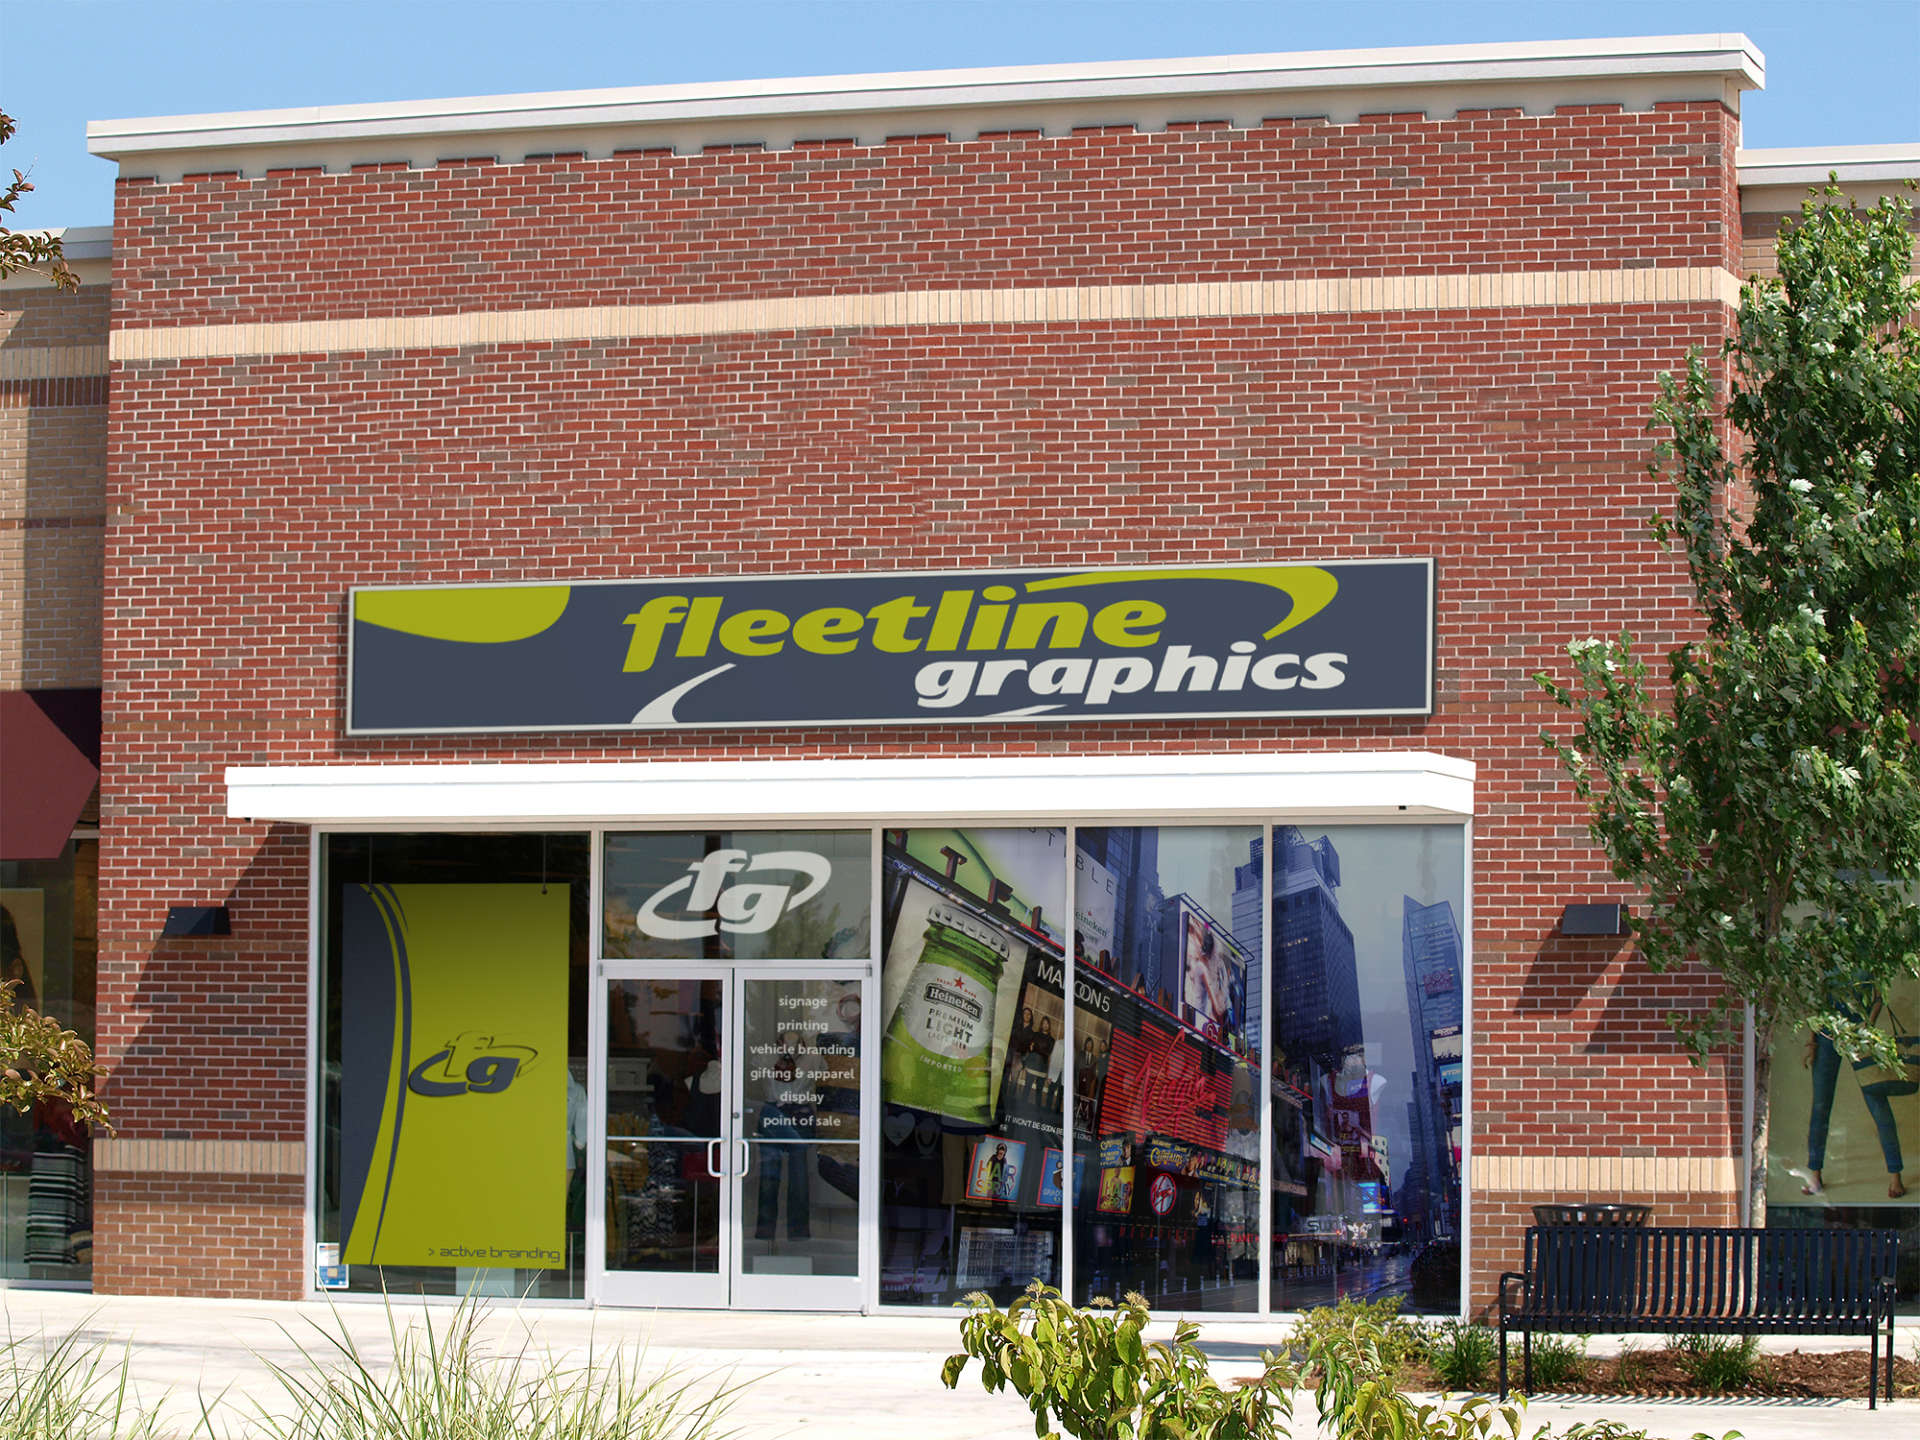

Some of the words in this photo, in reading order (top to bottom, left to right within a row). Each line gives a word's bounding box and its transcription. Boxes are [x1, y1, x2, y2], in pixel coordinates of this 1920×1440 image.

[622, 585, 1167, 673] fleetline
[914, 641, 1349, 708] graphics
[687, 849, 791, 934] fg
[1037, 960, 1101, 1008] MAOON
[1101, 996, 1111, 1012] 5
[778, 995, 828, 1009] signage
[929, 987, 979, 1017] Heineken
[777, 1019, 829, 1033] printing
[926, 1017, 973, 1043] LIGHT
[928, 1008, 974, 1031] PREMIUM
[750, 1043, 795, 1055] vehicle
[798, 1044, 855, 1057] branding
[750, 1067, 791, 1081] gifting
[795, 1067, 804, 1079] &
[807, 1068, 856, 1081] apparel
[780, 1091, 824, 1104] display
[763, 1115, 797, 1128] point
[799, 1115, 814, 1127] of
[815, 1115, 842, 1127] sale
[439, 1244, 486, 1258] active
[489, 1246, 561, 1264] branding
